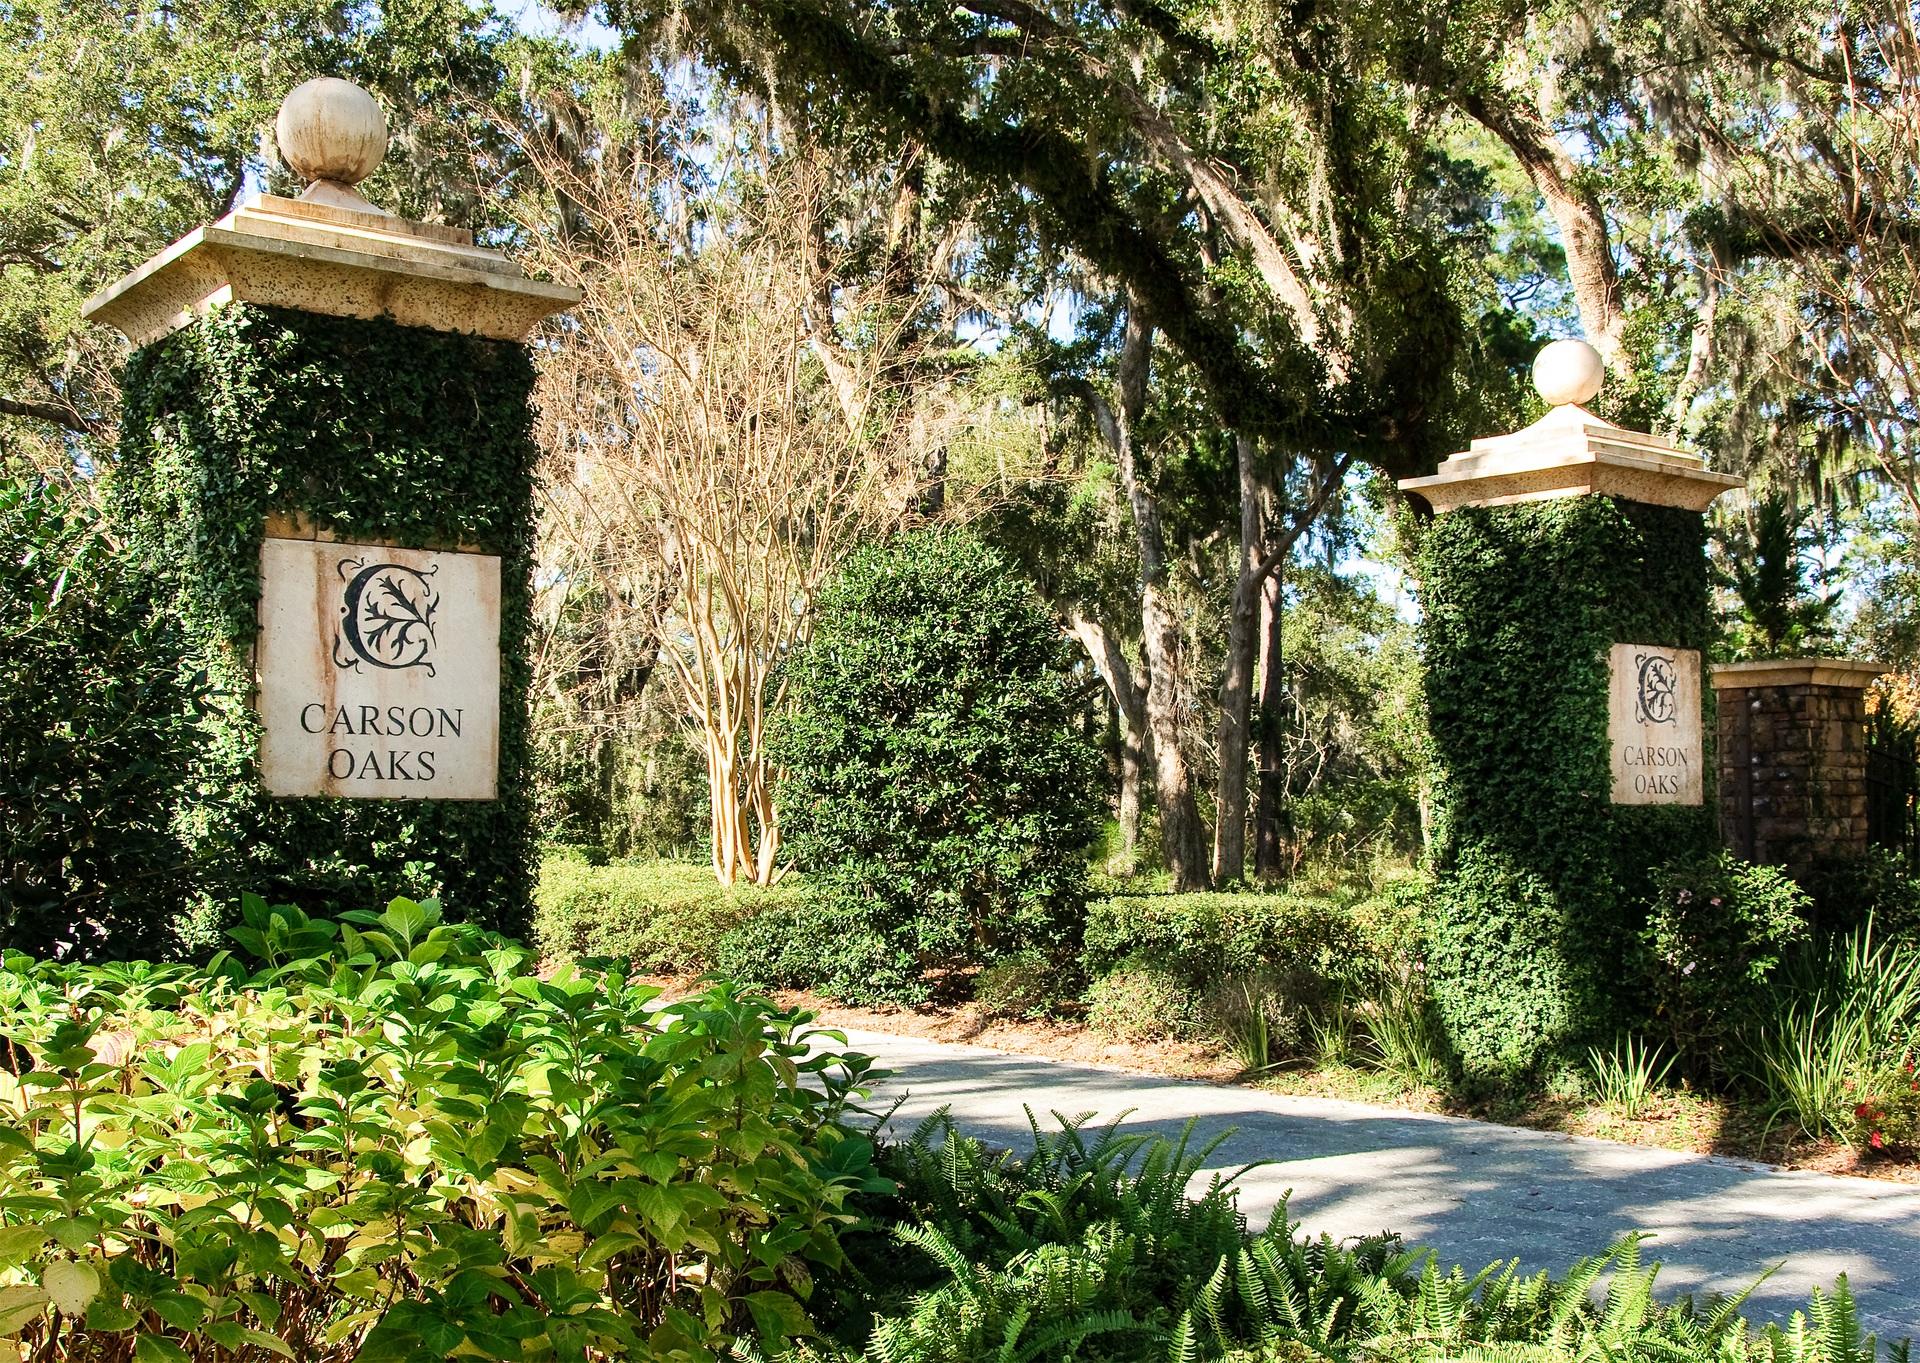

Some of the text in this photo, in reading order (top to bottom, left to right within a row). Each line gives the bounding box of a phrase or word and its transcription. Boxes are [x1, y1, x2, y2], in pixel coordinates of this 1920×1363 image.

[300, 703, 464, 738] CARSON
[327, 748, 436, 781] OAKS
[1623, 745, 1688, 767] CARSON
[1635, 774, 1679, 795] OAKS
